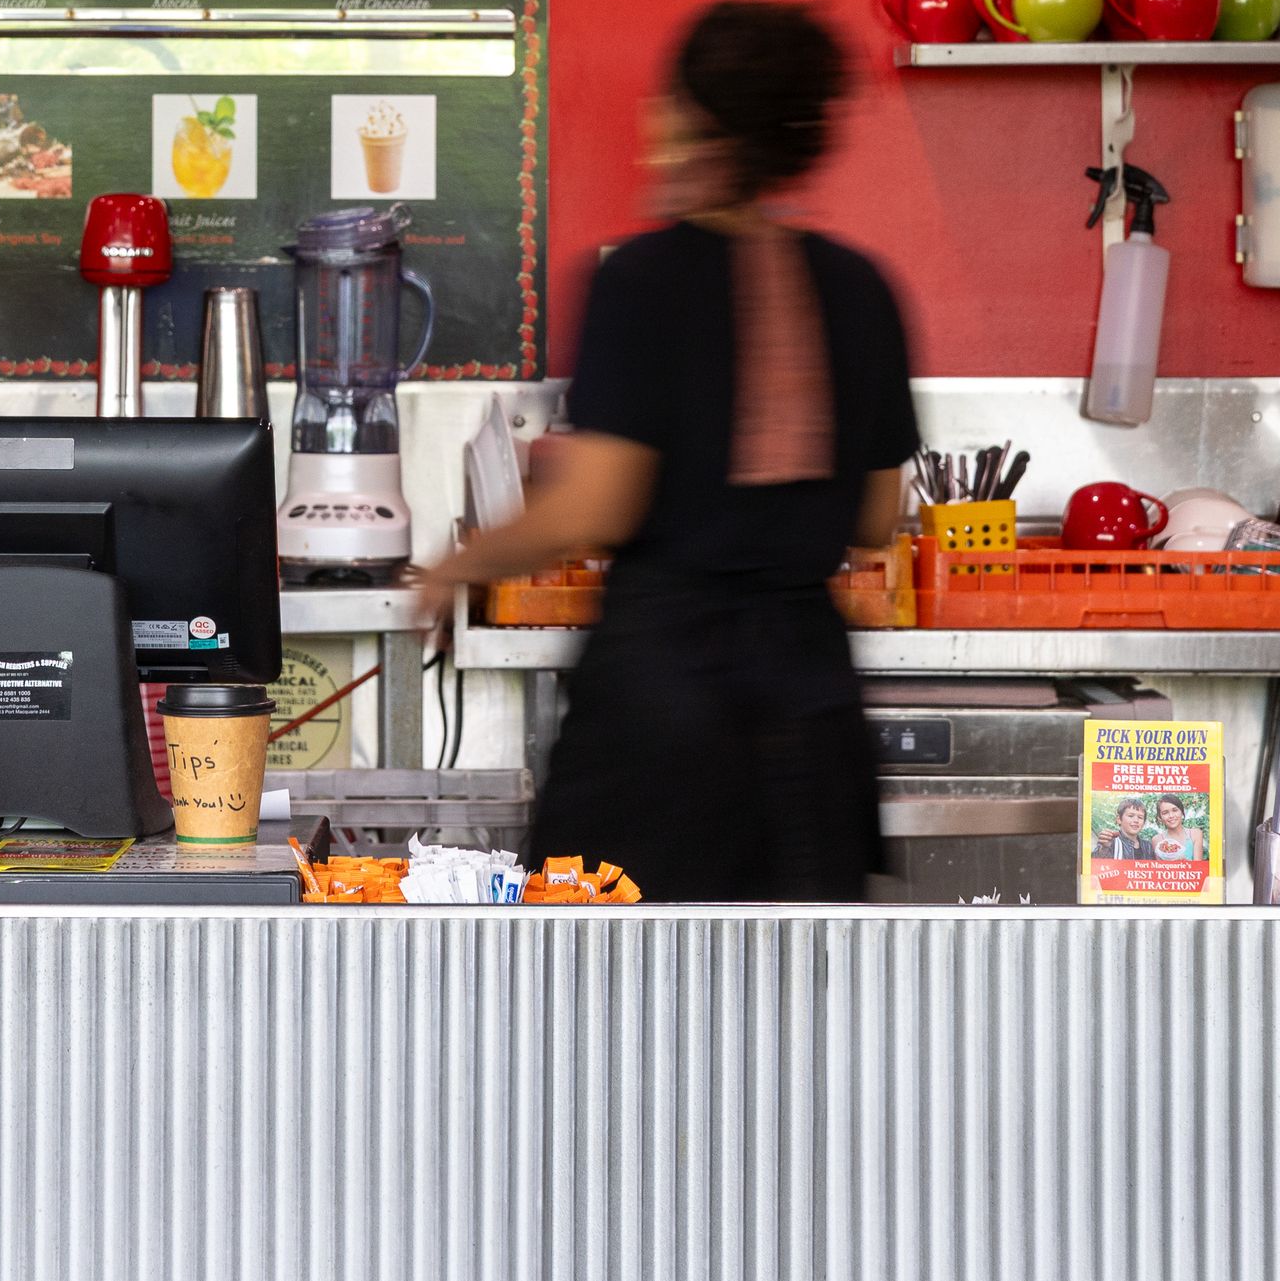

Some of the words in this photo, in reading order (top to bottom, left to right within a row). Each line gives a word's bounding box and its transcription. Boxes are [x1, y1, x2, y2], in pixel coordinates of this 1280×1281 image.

[6, 661, 34, 670] REGISTERS
[1096, 728, 1131, 743] PICK
[1135, 730, 1173, 745] YOUR
[1177, 730, 1208, 745] OWN
[1097, 746, 1208, 761] STRAWBERRIES
[169, 744, 216, 780] Tips
[1113, 764, 1144, 775] FREE
[1148, 765, 1188, 775] ENTRY
[1113, 775, 1143, 784] OPEN
[1157, 776, 1189, 784] DAYS
[193, 796, 223, 812] You!
[1151, 862, 1192, 870] Macquarie's
[1156, 871, 1202, 880] TOURIST
